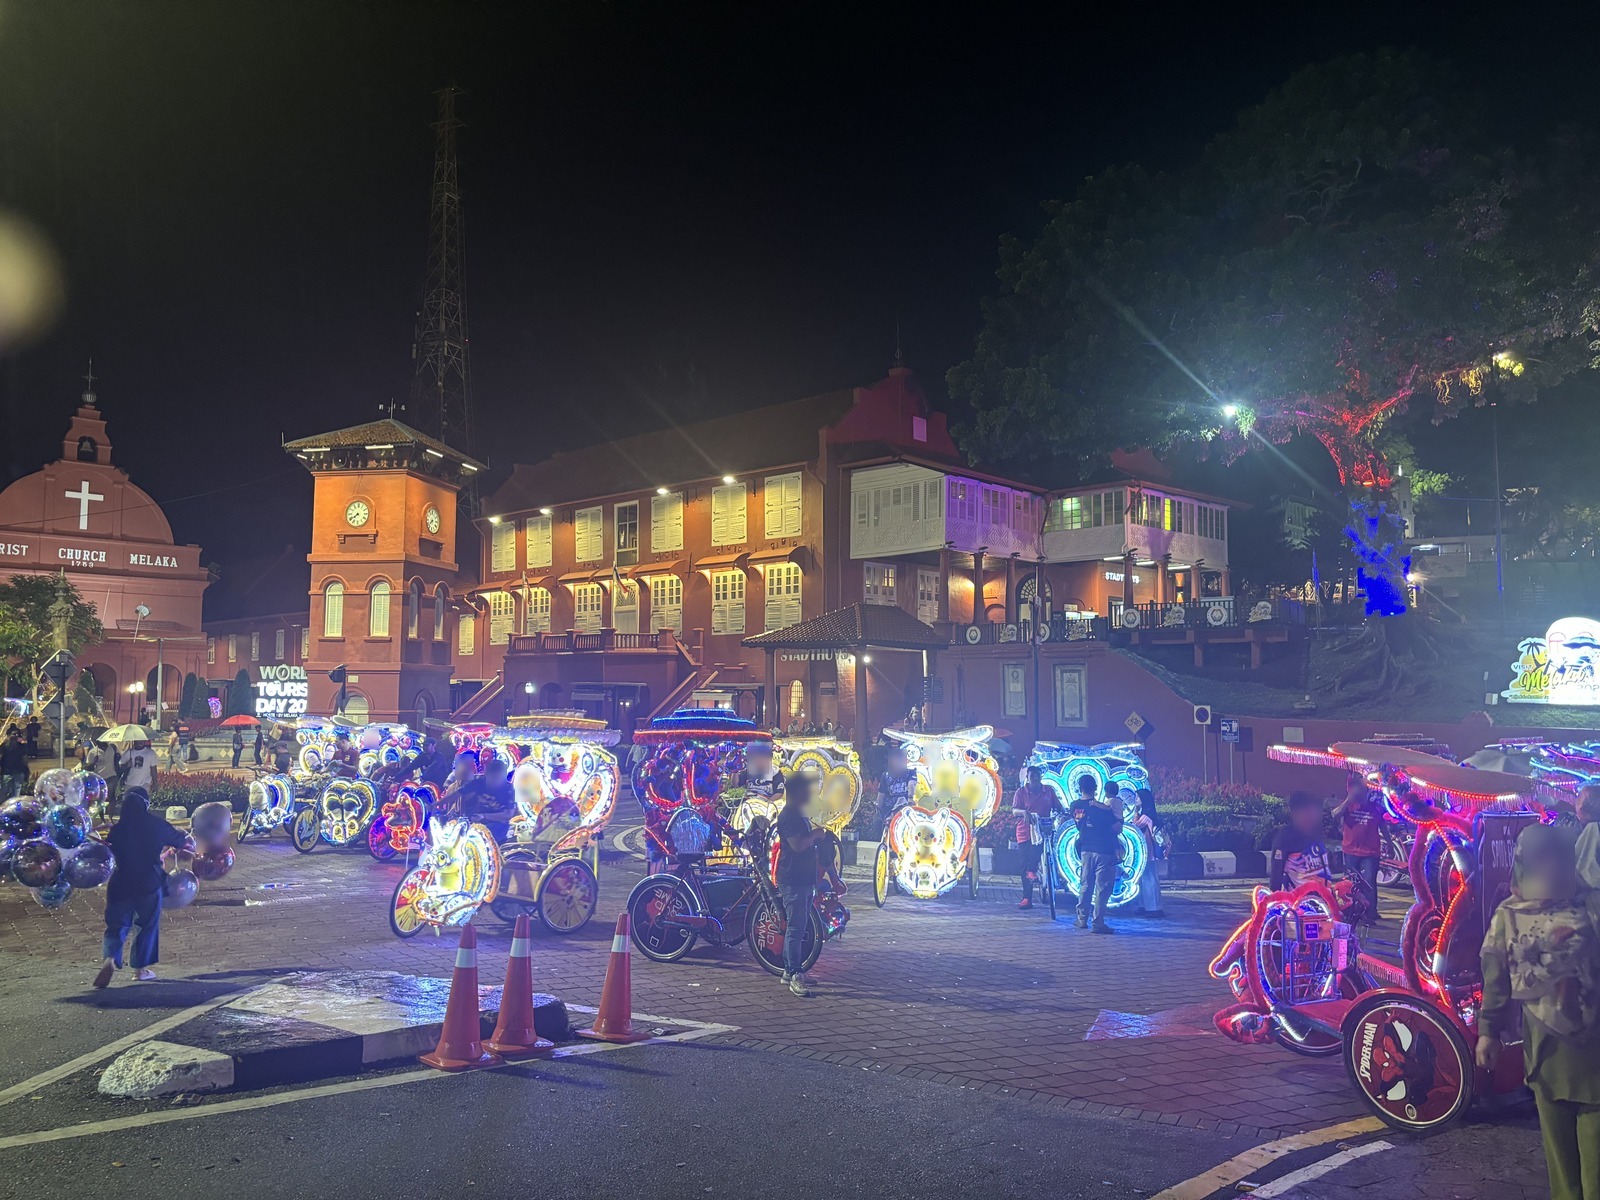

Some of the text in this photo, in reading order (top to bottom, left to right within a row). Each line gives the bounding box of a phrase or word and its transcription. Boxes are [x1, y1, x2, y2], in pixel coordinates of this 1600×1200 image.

[58, 548, 106, 563] CHURCH
[129, 553, 178, 568] MELAKA
[255, 698, 287, 713] DAY
[757, 911, 772, 951] GAME
[1360, 1022, 1378, 1082] SPIDER-MAN
